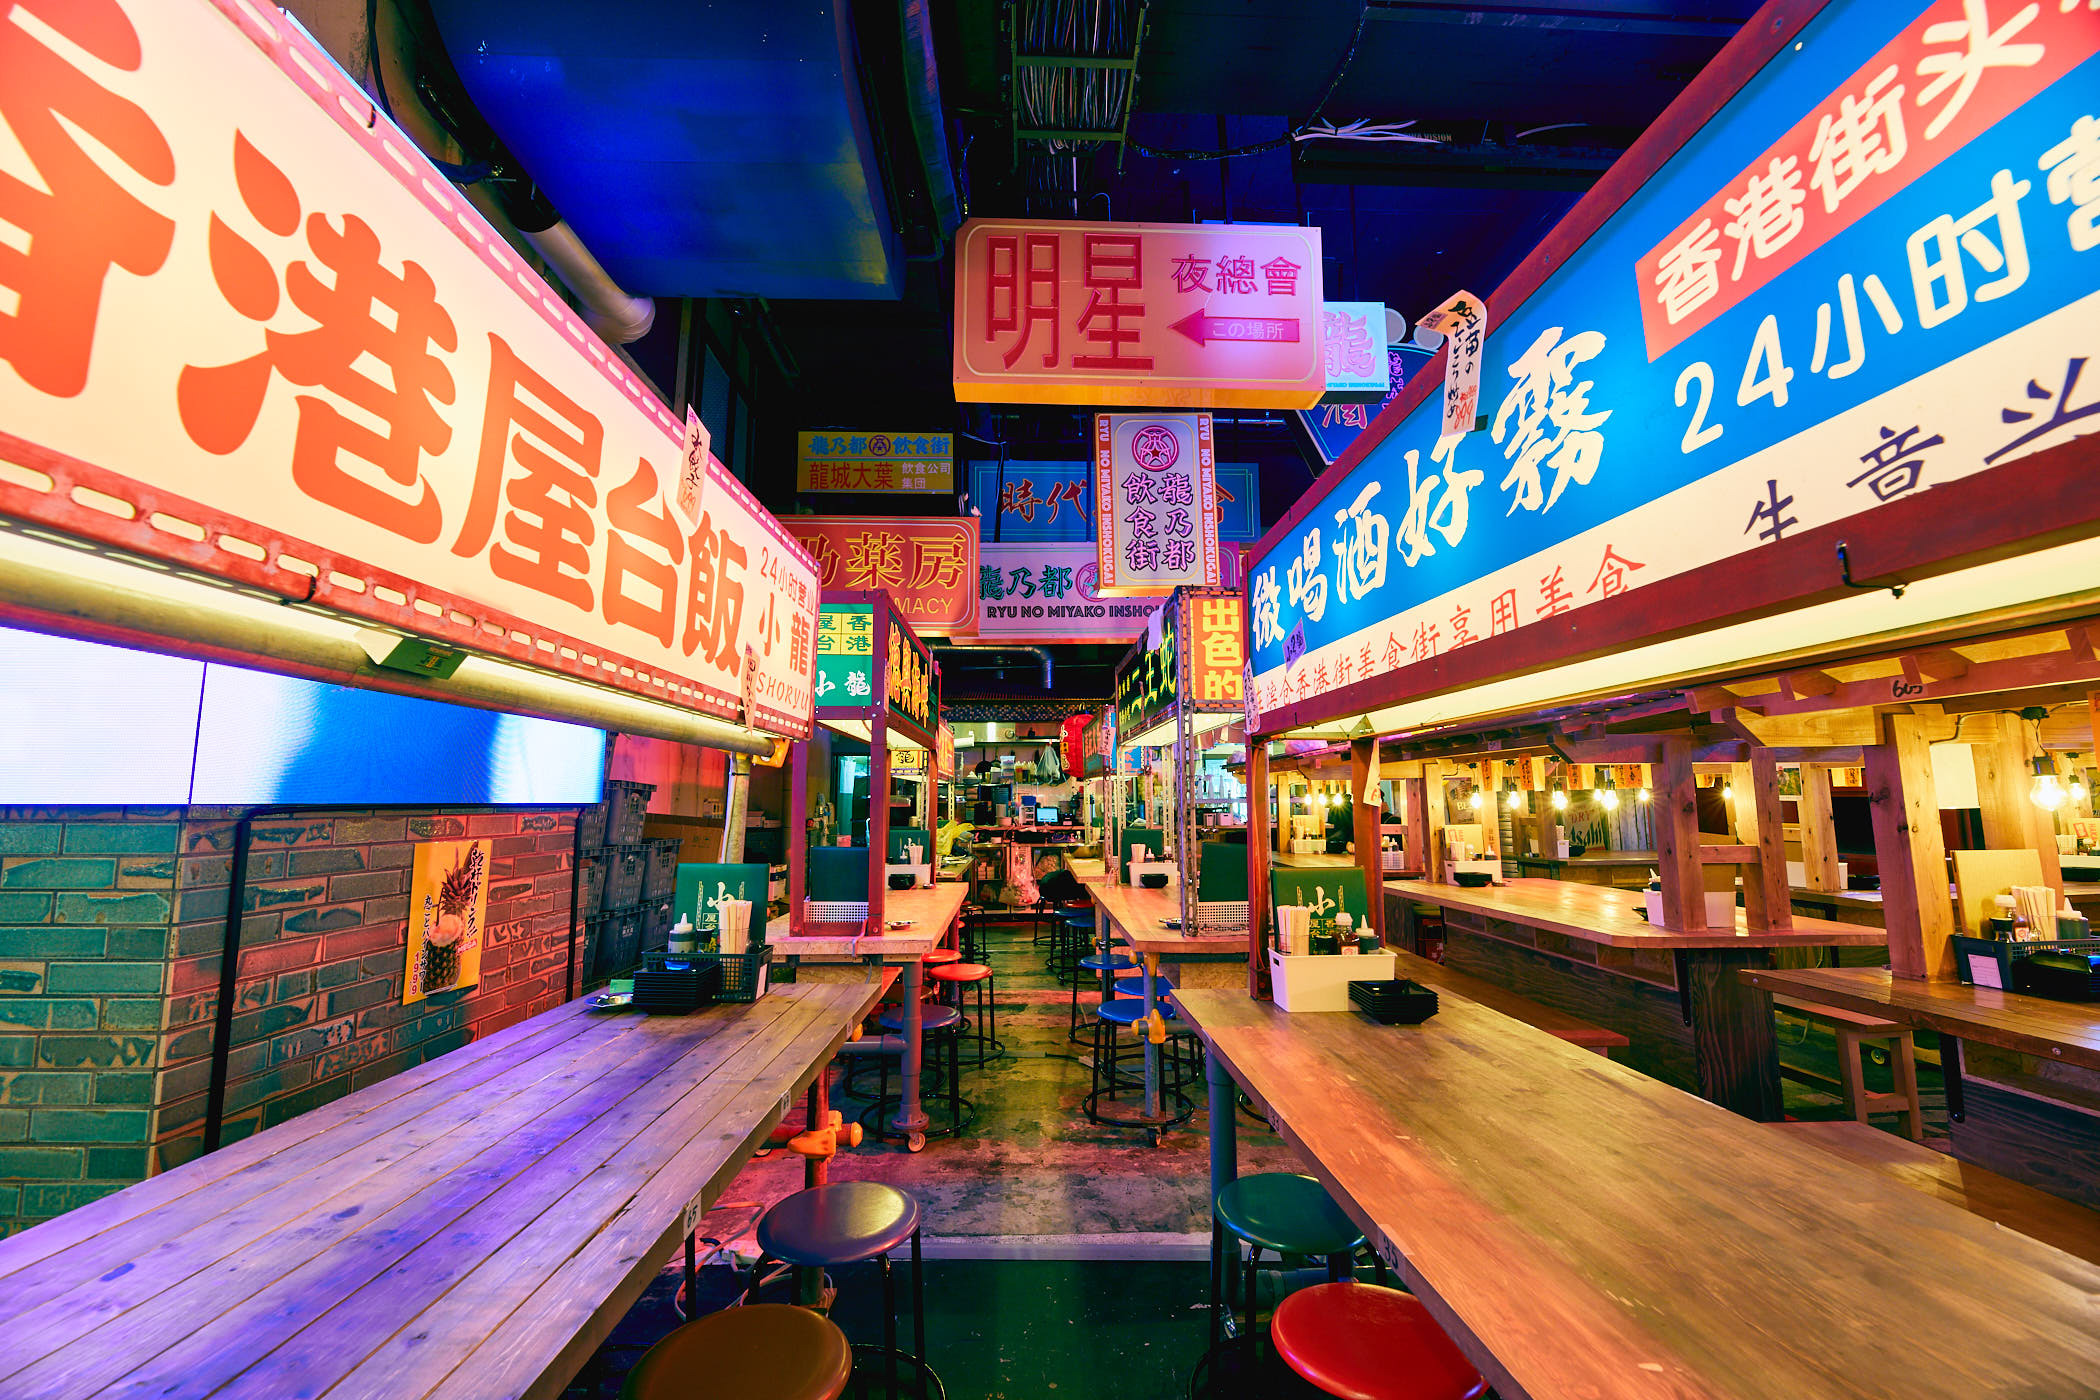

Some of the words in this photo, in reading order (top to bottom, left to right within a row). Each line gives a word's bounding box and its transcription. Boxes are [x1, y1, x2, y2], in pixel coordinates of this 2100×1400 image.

[1655, 0, 2100, 325] 香港街头
[1170, 255, 1302, 297] 夜總會
[984, 232, 1155, 371] 明星
[1212, 321, 1285, 340] この場所
[1322, 311, 1376, 378] 龍
[807, 435, 868, 456] 龍乃都
[892, 435, 951, 456] 飲食街
[1099, 419, 1110, 442] RYU
[1199, 417, 1210, 441] RYU
[808, 461, 894, 490] 龍城大葉
[901, 462, 951, 475] 飲食公司
[1100, 450, 1111, 467] NO
[1200, 448, 1211, 467] NO
[1100, 468, 1112, 512] MIYAKO
[1201, 467, 1213, 511] MIYAKO
[1120, 471, 1160, 572] 飲食街
[1158, 472, 1196, 572] 龍乃都
[1102, 513, 1114, 584] INSHOKUGAI
[1204, 512, 1217, 584] INSHOKUGAI
[979, 564, 1073, 600] 龍乃都
[987, 605, 1018, 618] RYU
[1020, 605, 1044, 618] NO
[1048, 605, 1106, 618] MIYAKO
[1109, 605, 1160, 618] INSHO
[759, 592, 811, 678] 小龍
[1201, 598, 1243, 701] 出色的
[755, 671, 809, 712] SHORYU
[411, 951, 421, 995] 1999
[1383, 1235, 1399, 1270] 35
